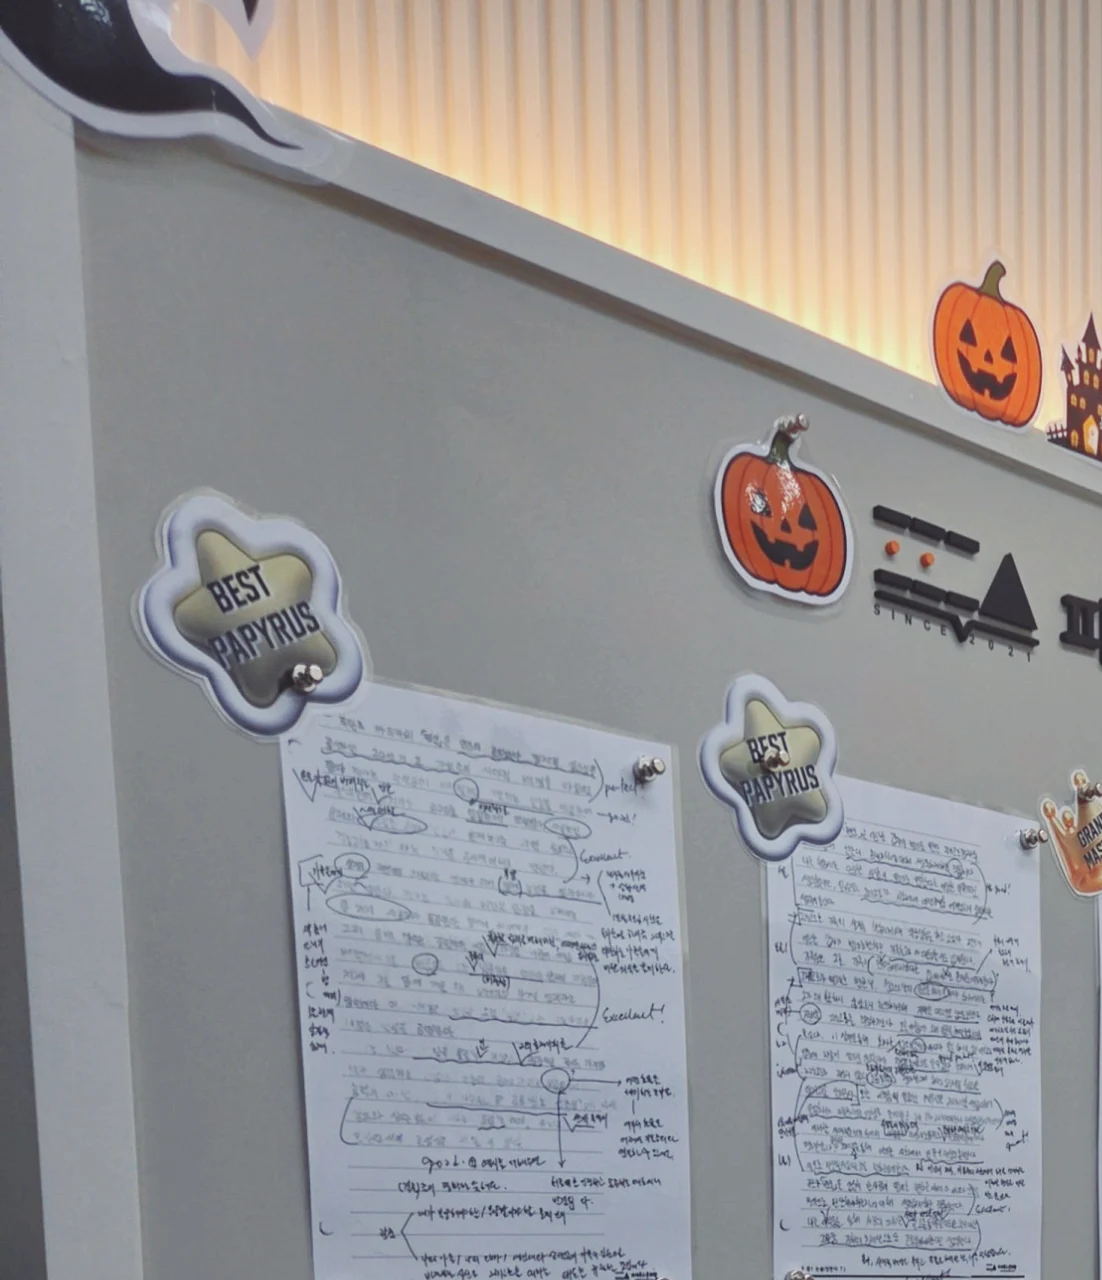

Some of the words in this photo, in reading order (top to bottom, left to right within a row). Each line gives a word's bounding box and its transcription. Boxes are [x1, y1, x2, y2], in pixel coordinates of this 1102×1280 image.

[206, 565, 271, 614] BEST
[208, 601, 320, 669] PAPYRUS
[873, 603, 947, 637] SINCE
[968, 633, 1031, 663] 2021
[746, 732, 790, 763] BEST
[740, 764, 820, 806] PAPYRUS
